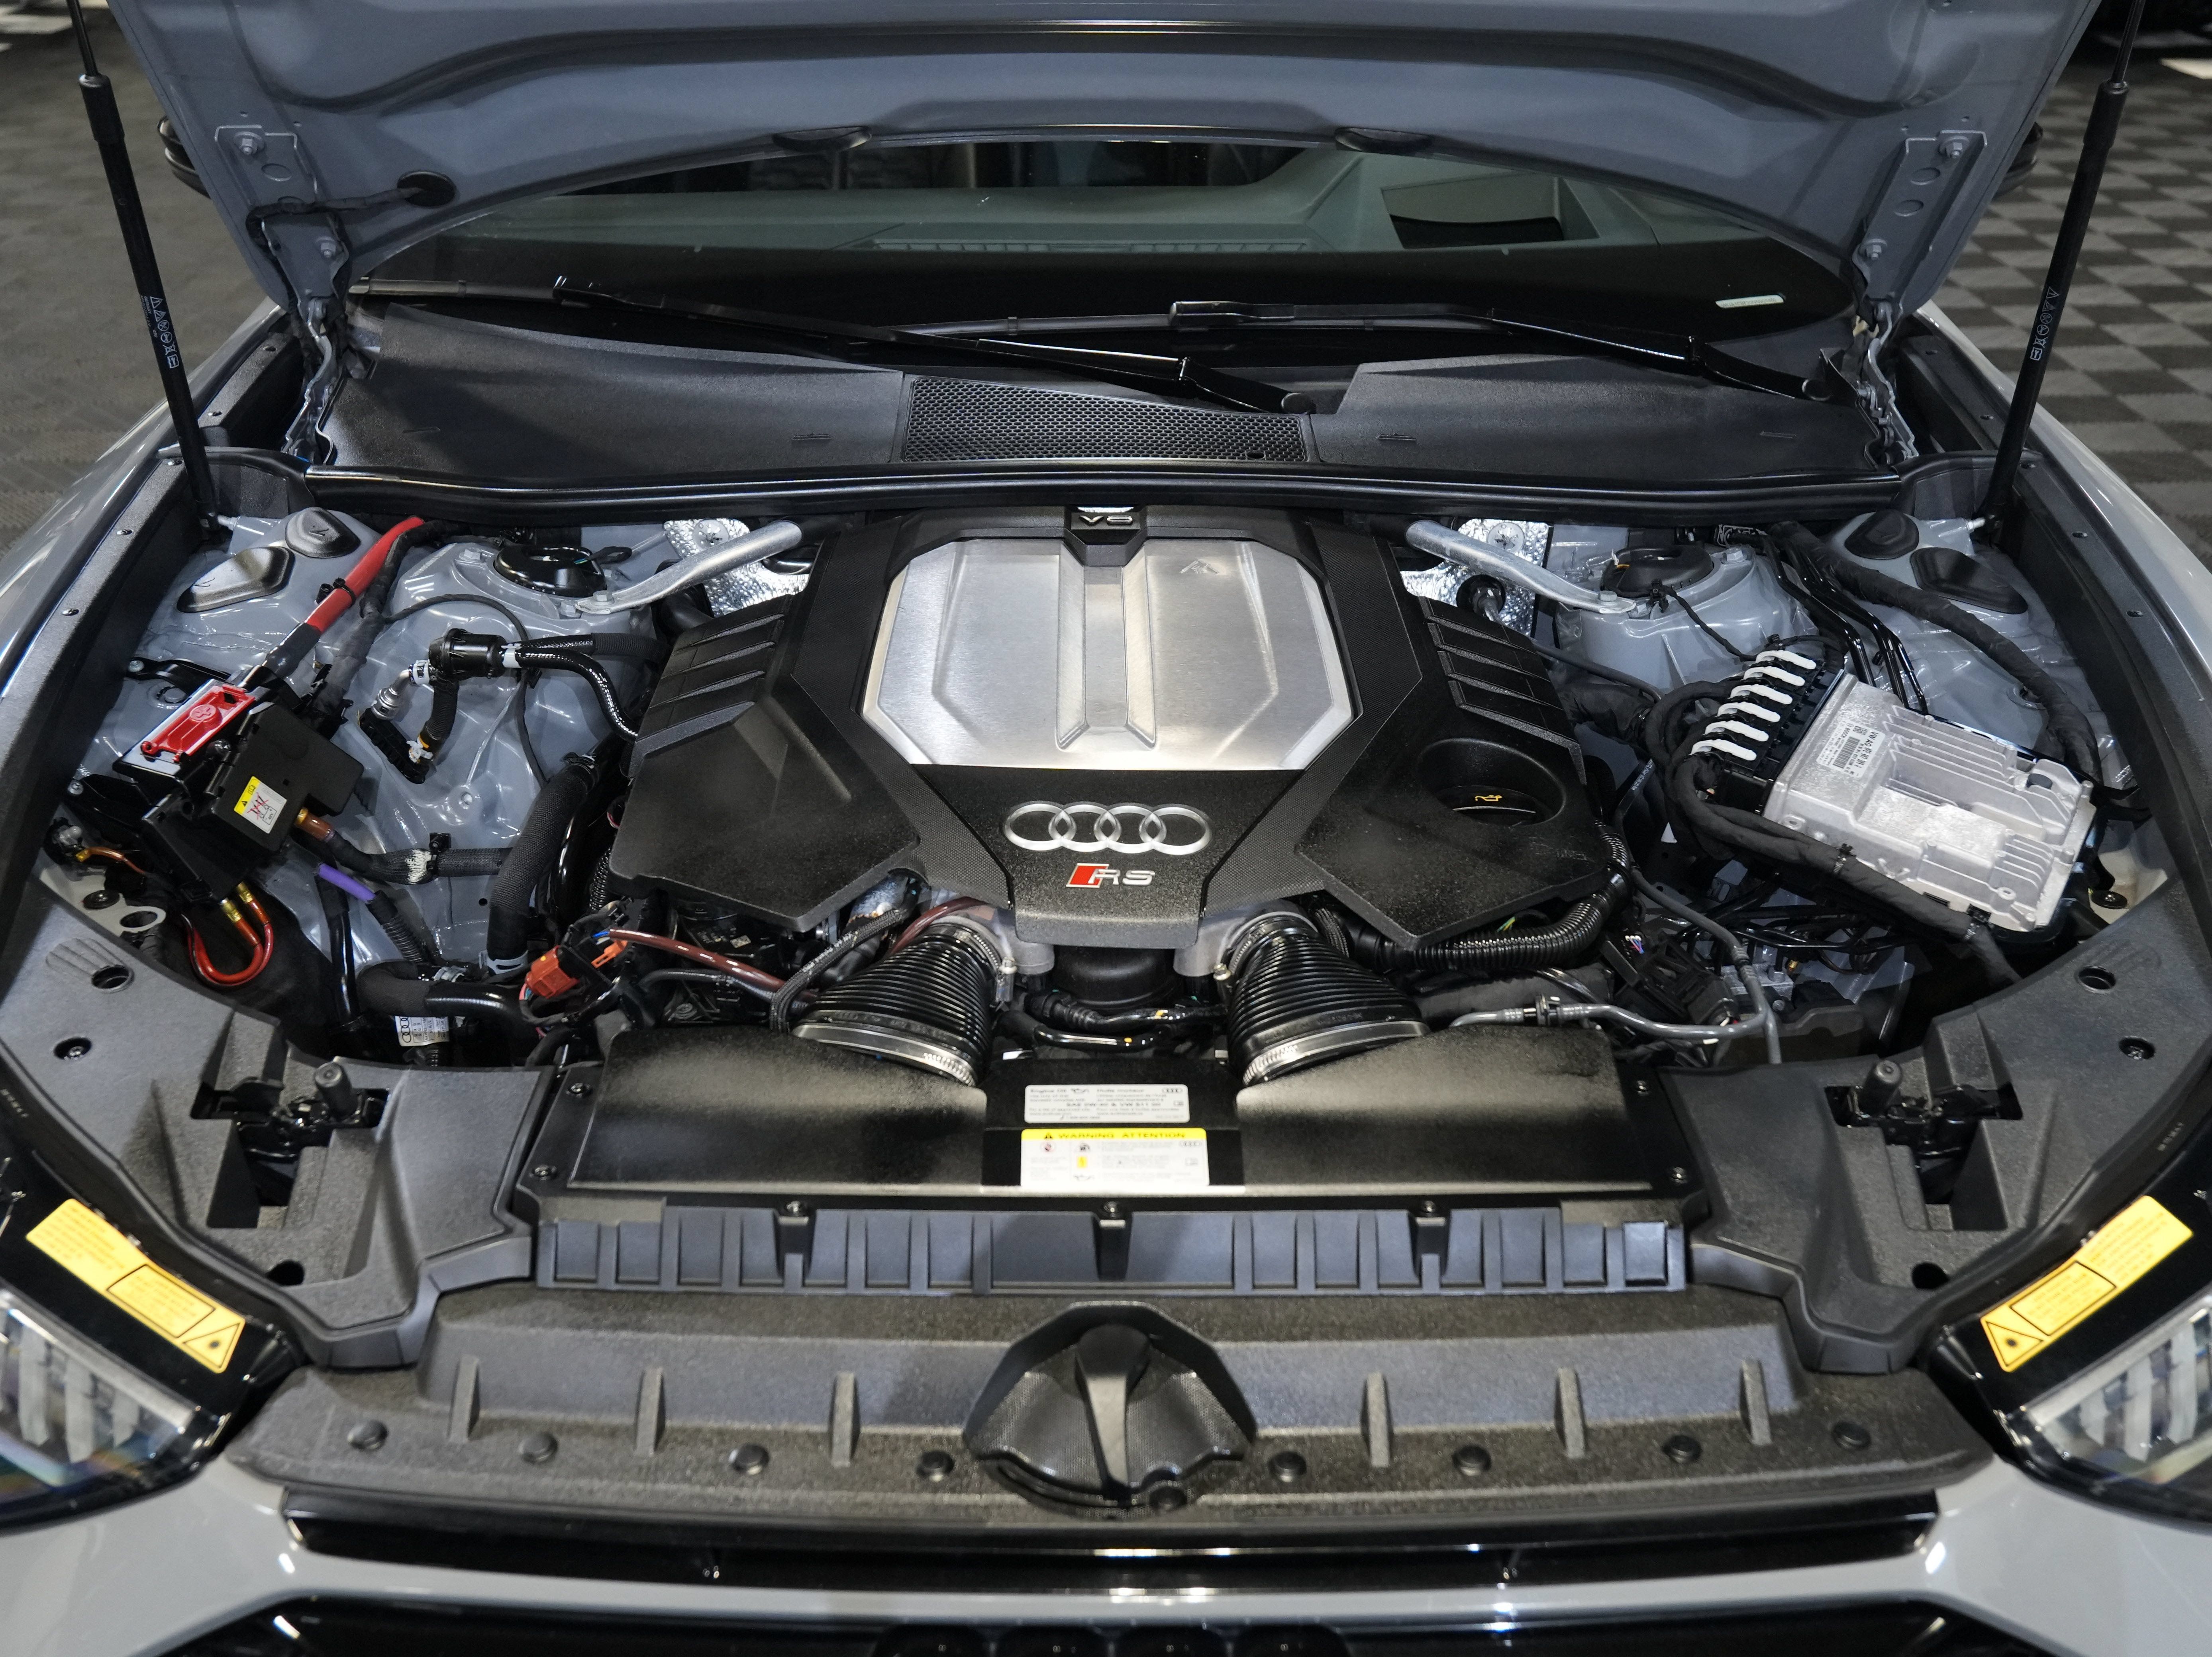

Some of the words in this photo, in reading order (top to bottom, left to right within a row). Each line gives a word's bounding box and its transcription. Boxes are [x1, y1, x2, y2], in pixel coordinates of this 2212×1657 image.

[1840, 727, 1851, 738] BOSCH
[1869, 731, 1879, 740] VW
[1864, 738, 1873, 747] AG
[1088, 868, 1155, 885] RS
